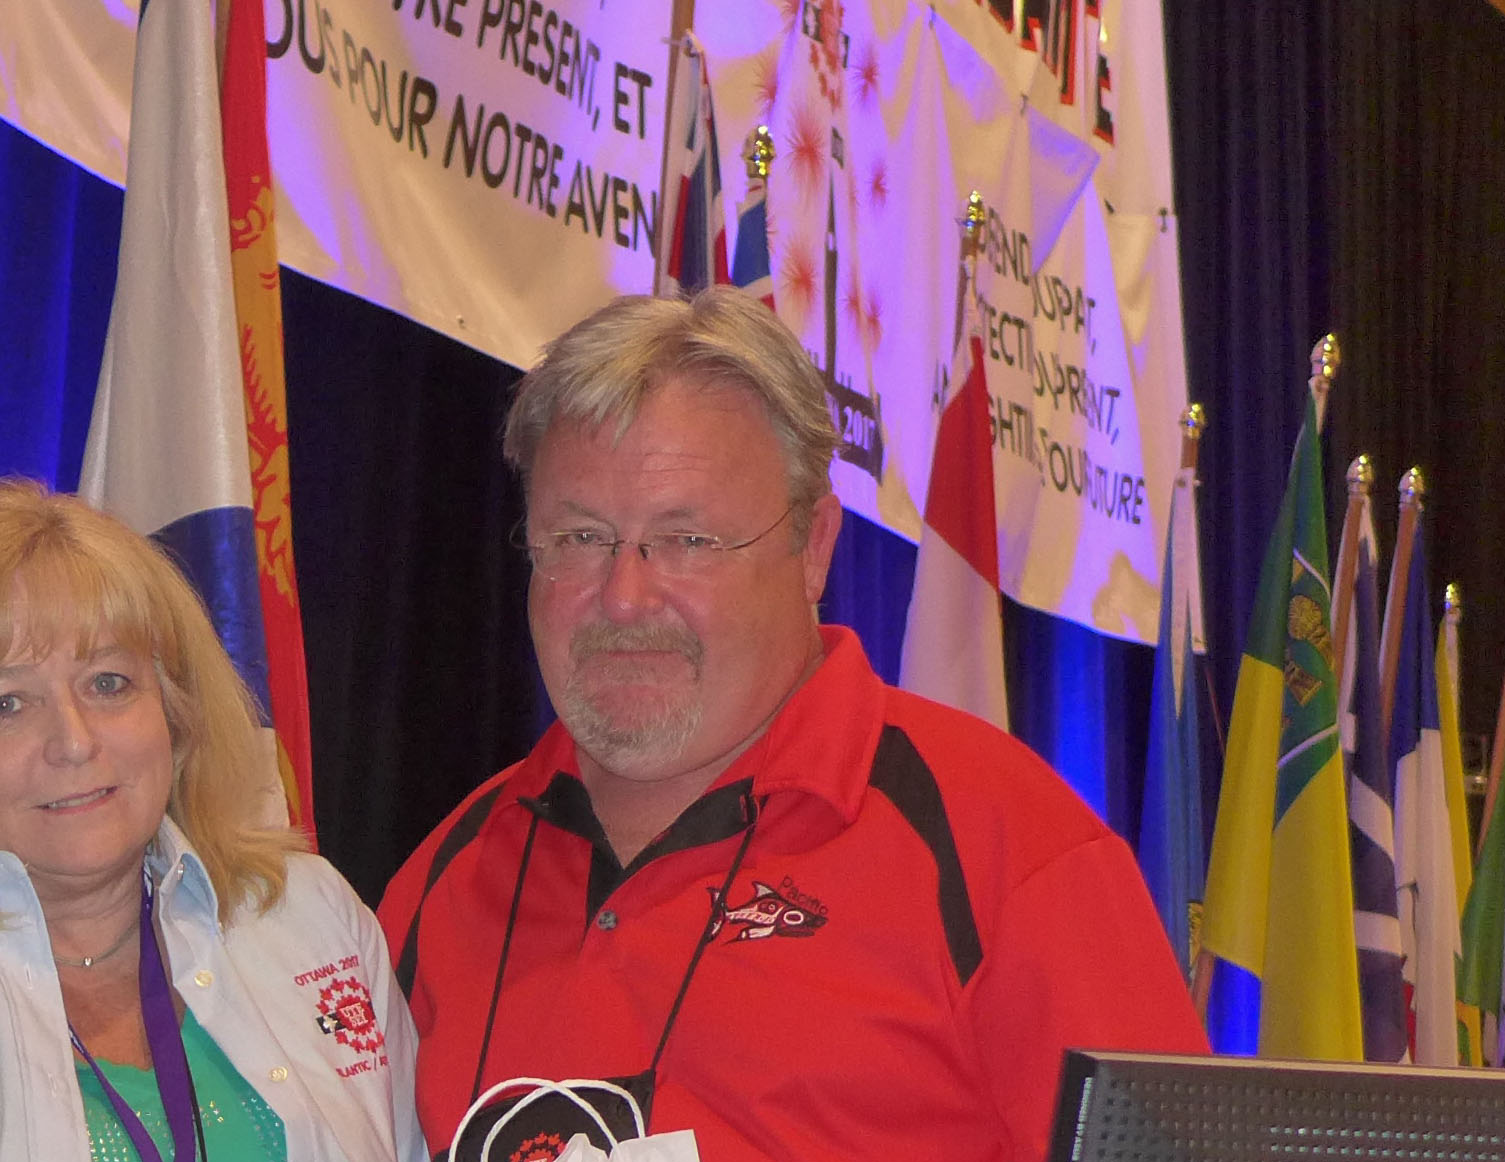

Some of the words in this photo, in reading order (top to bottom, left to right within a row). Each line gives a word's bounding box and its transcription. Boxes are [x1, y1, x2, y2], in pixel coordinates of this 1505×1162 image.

[477, 0, 601, 131] PRESENT,
[612, 61, 653, 140] ET
[343, 29, 438, 160] POUR
[443, 93, 565, 219] NOTRE
[564, 159, 658, 260] AVEN
[843, 405, 877, 452] 2017
[294, 963, 340, 987] OTTAWA
